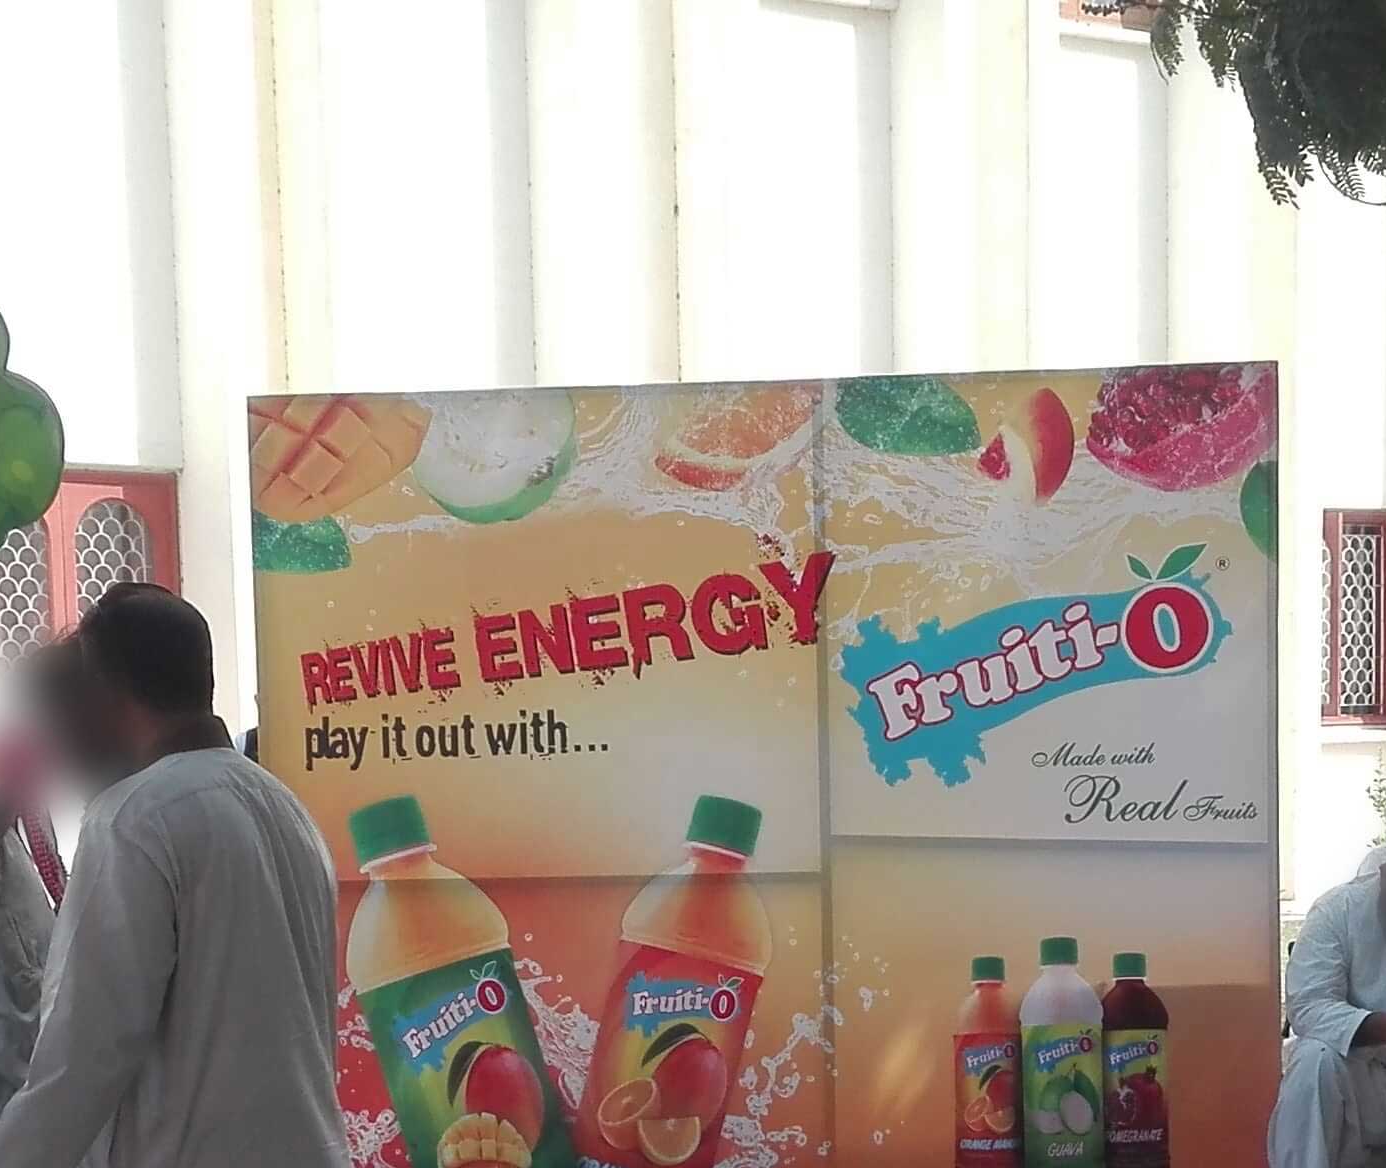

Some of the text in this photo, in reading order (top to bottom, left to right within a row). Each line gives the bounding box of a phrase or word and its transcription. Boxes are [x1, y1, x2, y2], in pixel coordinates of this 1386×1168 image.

[300, 551, 837, 708] REVIVE ENERGY
[867, 582, 1214, 741] Fruiti-O
[304, 717, 369, 770] play
[380, 713, 407, 761] it
[416, 713, 476, 760] out
[1031, 741, 1155, 768] Made with
[1063, 774, 1258, 825] Real Fruits
[402, 977, 507, 1060] Fruiti-O
[631, 976, 738, 1023] Fruiti-O
